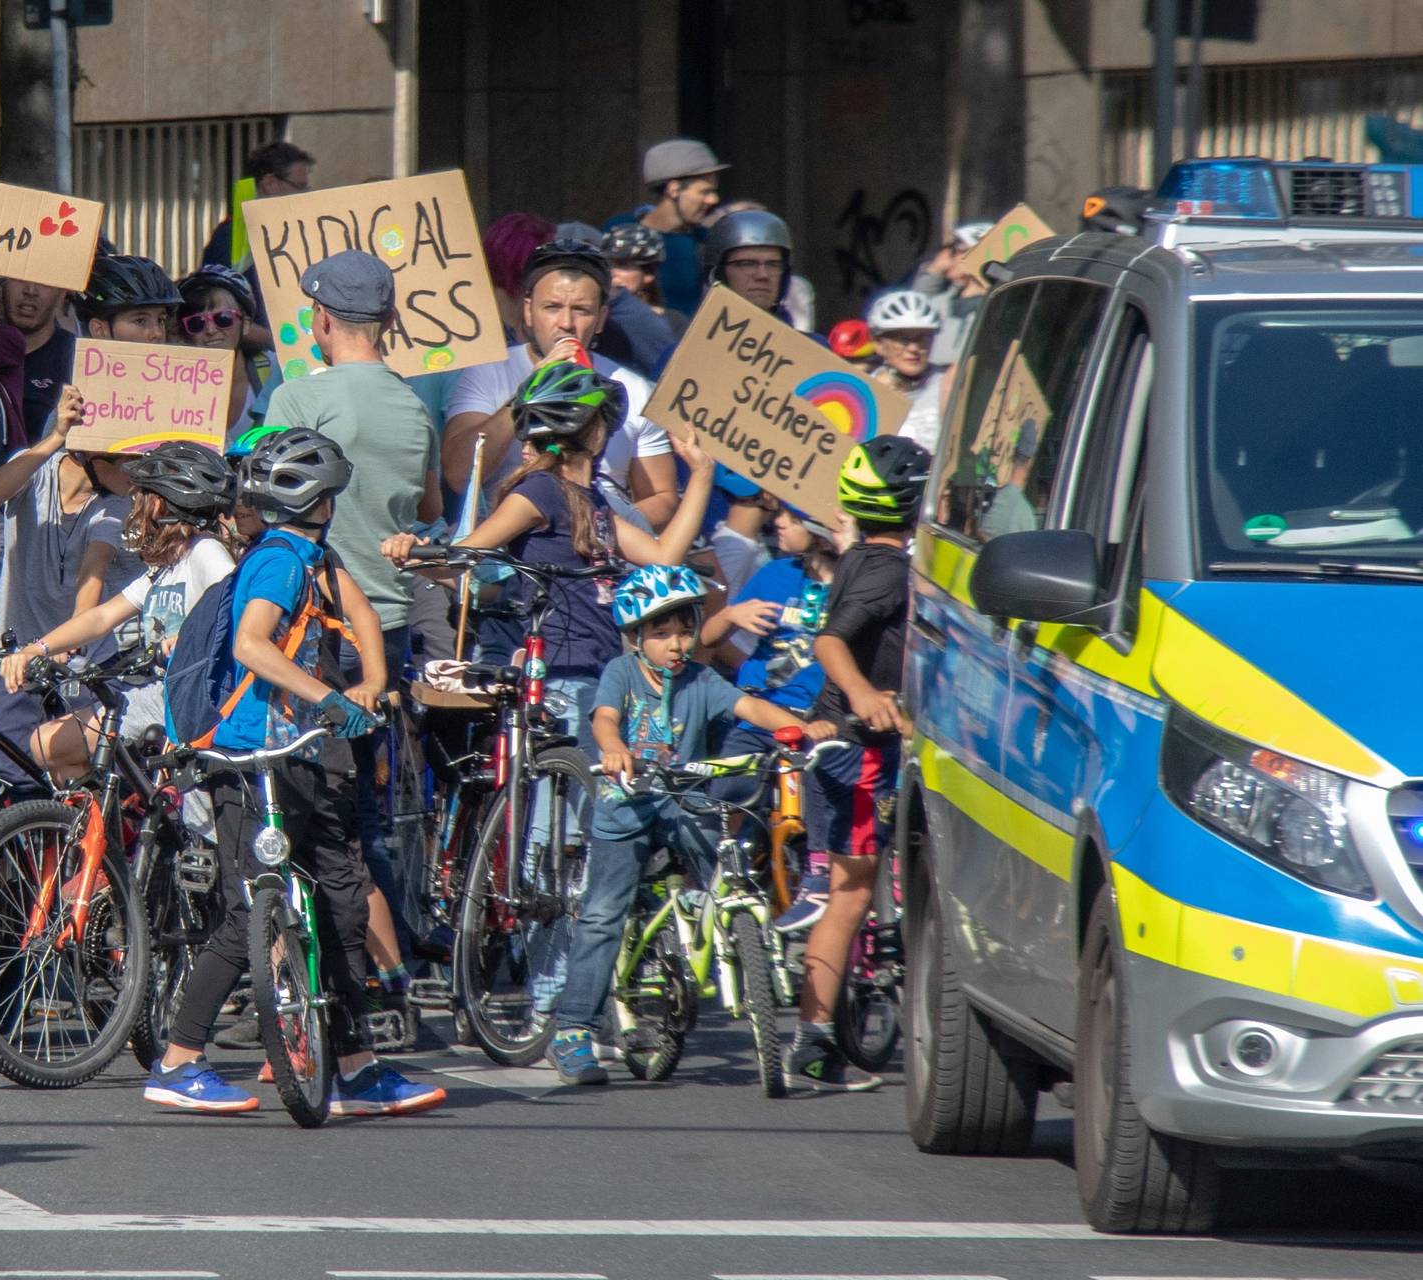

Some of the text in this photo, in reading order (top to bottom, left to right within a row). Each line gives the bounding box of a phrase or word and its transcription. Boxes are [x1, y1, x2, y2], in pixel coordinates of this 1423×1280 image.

[379, 279, 482, 357] ASS
[706, 305, 794, 378] Mehr
[84, 347, 224, 395] Die Straße
[81, 391, 217, 432] gehört uns!
[668, 378, 818, 490] Radwege!
